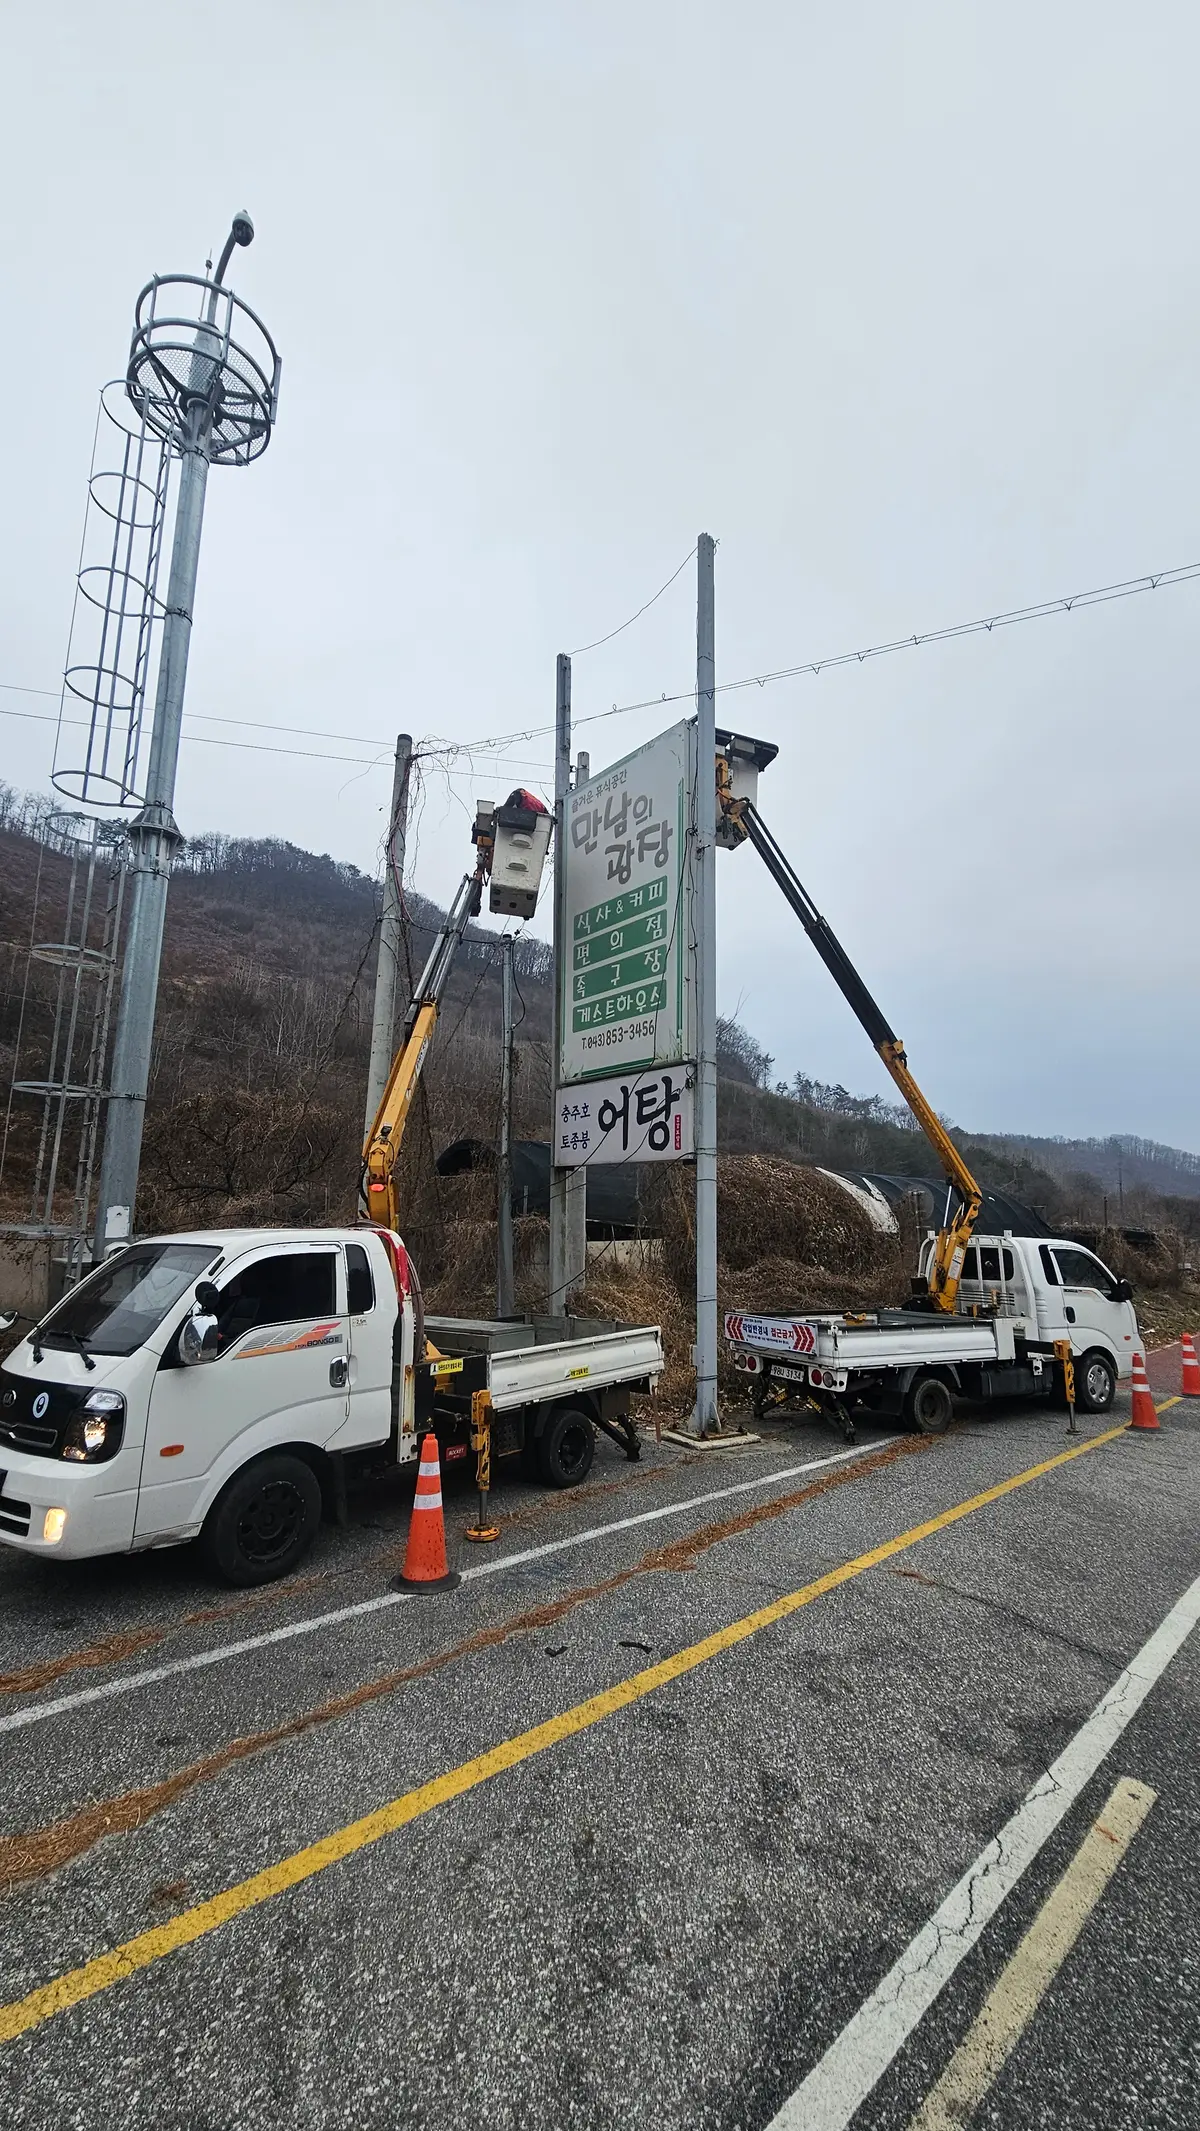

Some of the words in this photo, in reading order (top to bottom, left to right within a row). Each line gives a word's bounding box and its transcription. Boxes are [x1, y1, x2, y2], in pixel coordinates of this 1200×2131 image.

[572, 791, 594, 814] 즐거운
[595, 769, 628, 799] 휴식공간
[570, 790, 653, 855] 만남의
[576, 914, 663, 967] 편의점
[576, 949, 662, 998] 족구장
[576, 986, 662, 1023] 게스트하우스
[560, 1102, 591, 1123] 충주호
[597, 1075, 681, 1151] 어탕
[560, 1129, 591, 1150] 토종붕
